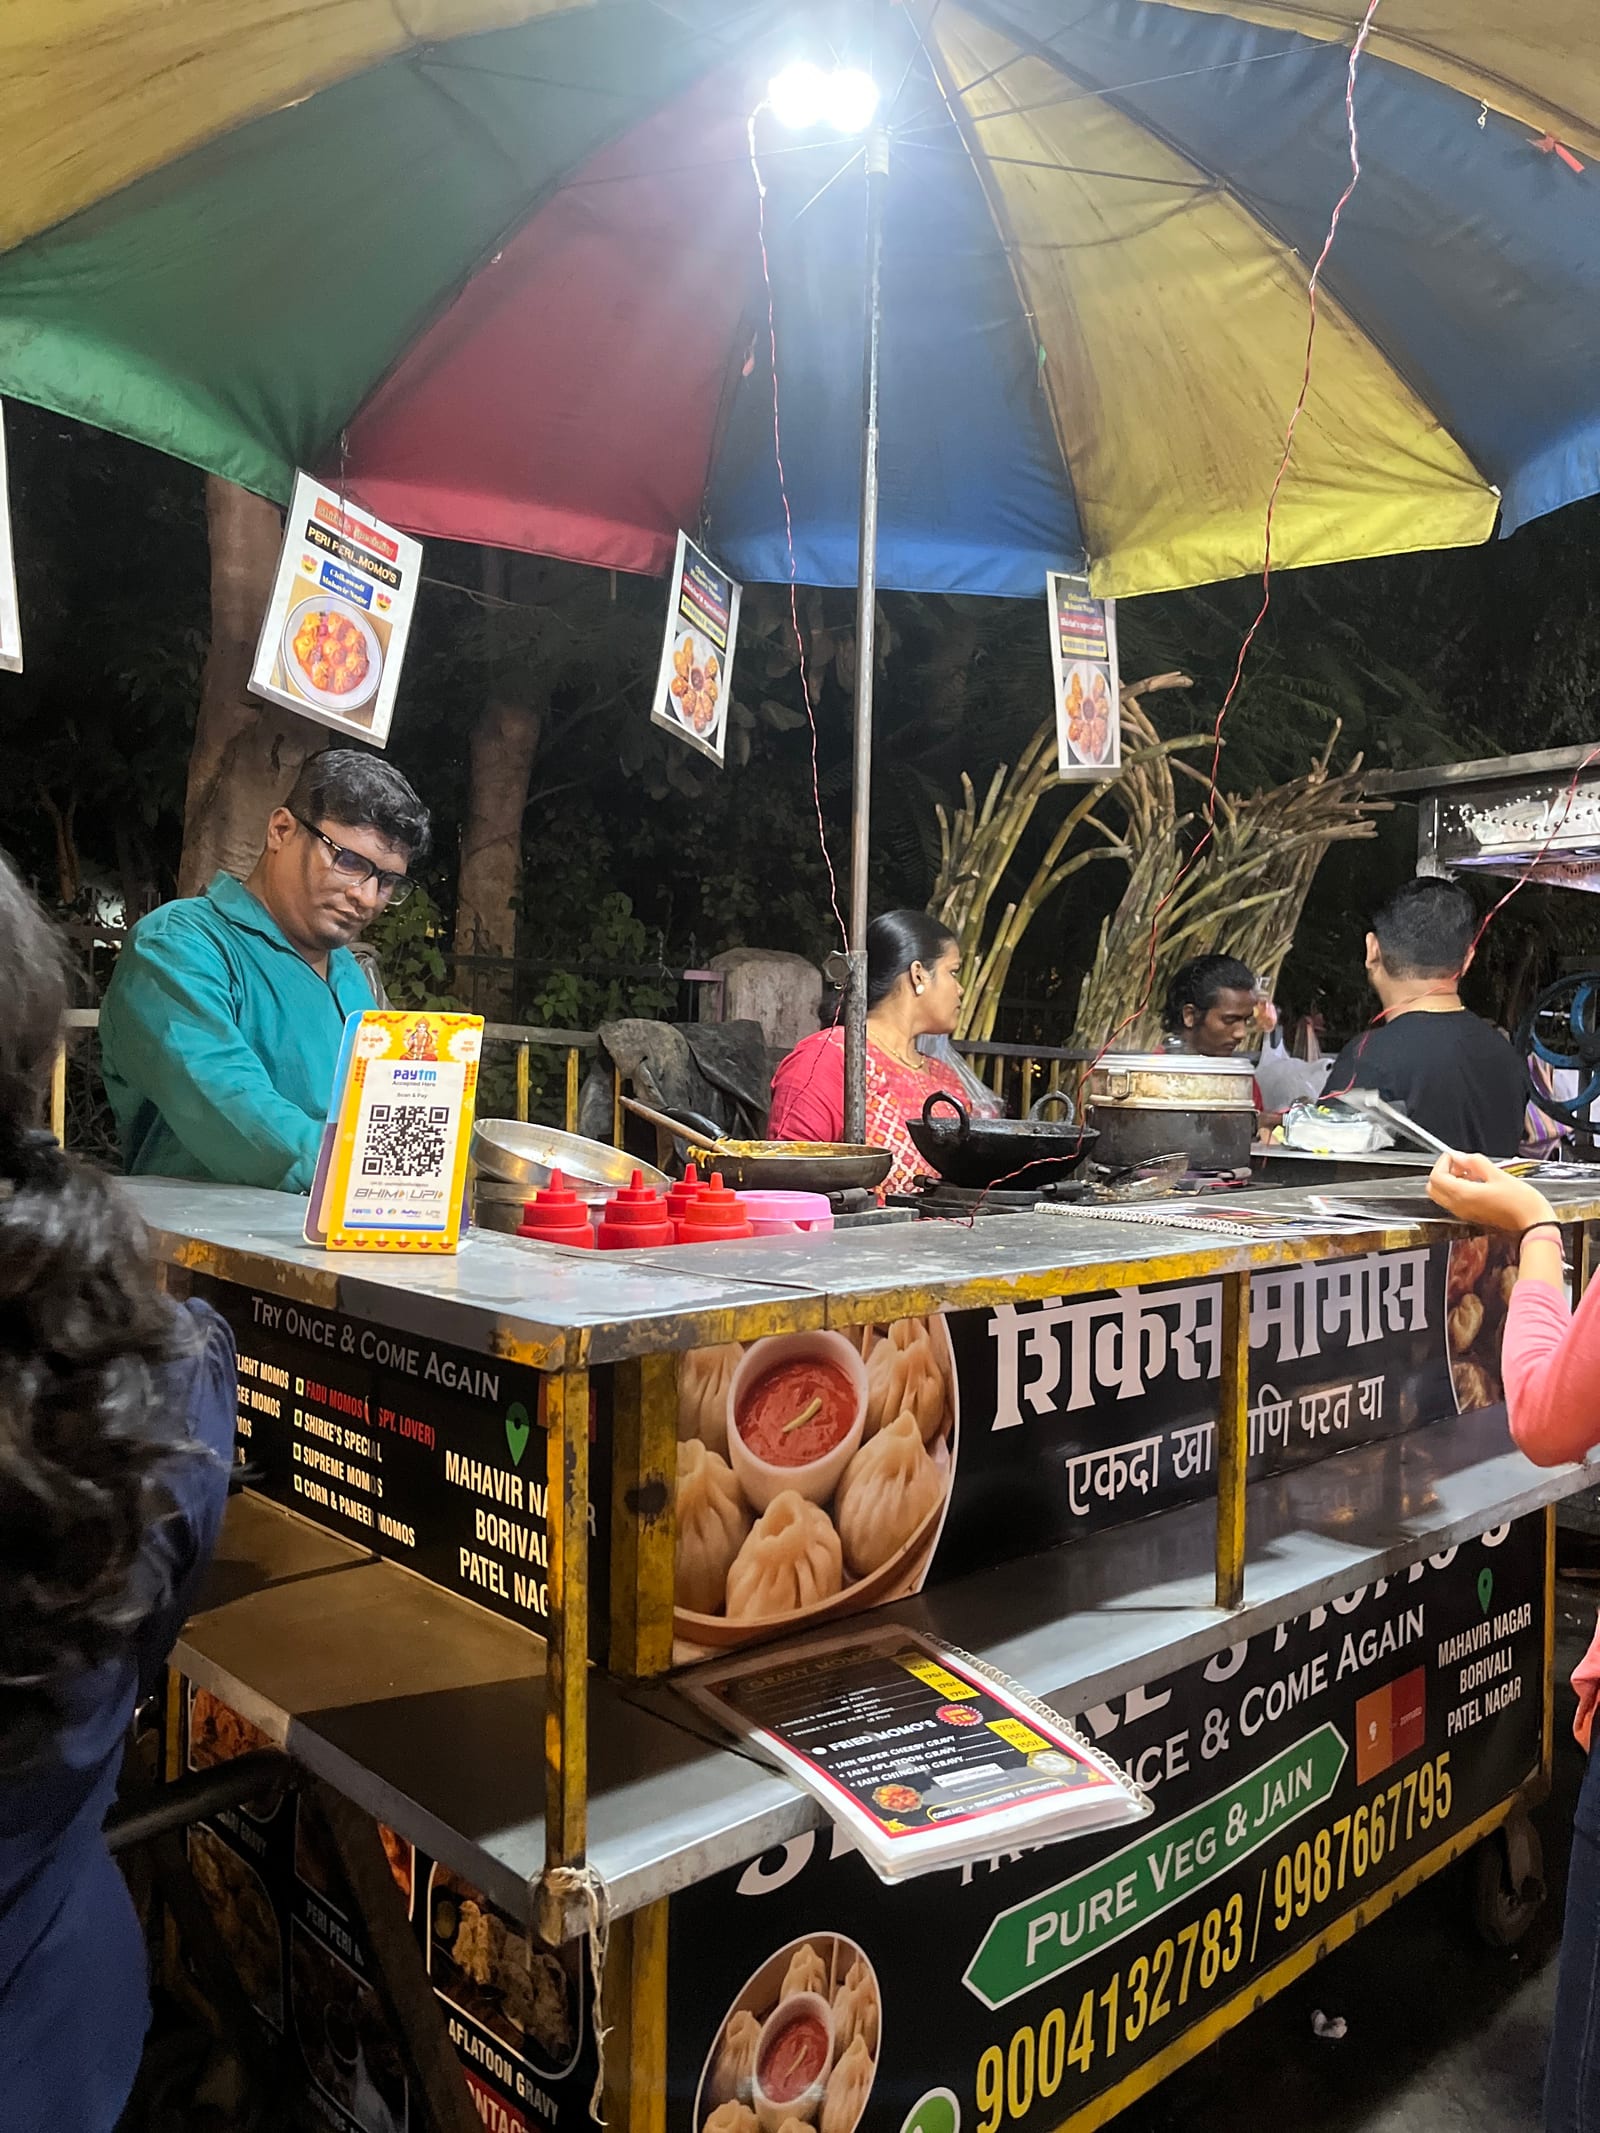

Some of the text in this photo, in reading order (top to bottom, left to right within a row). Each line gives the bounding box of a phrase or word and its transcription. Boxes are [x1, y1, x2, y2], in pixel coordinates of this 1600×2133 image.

[308, 526, 331, 547] PERI
[354, 1188, 438, 1199] BHIM UPI
[340, 1324, 355, 1354] &
[236, 1353, 289, 1390] LIGHT MOMOS
[251, 1390, 280, 1419] MOMOS
[306, 1380, 327, 1404] FADU
[329, 1389, 363, 1418] MOMOS
[400, 1415, 435, 1451] LOVER)
[304, 1412, 382, 1463] SHIRKE'S SPECIAL
[1066, 1435, 1163, 1516] एकदा
[1171, 1421, 1216, 1479] खा
[1300, 1383, 1353, 1439] परत
[1358, 1375, 1385, 1421] या
[303, 1446, 383, 1498] SUPREME MOMOS
[446, 1450, 523, 1509] MAHAVIR
[304, 1479, 415, 1548] CORN & PANEER MOMOS
[475, 1508, 549, 1569] BORIVAL
[459, 1547, 509, 1600] PATEL
[1438, 1602, 1532, 1669] MAHAVIR NAGAR
[1460, 1646, 1512, 1694] BORIVALI
[1448, 1675, 1522, 1738] PATEL NAGAR
[828, 1719, 938, 1752] FRIED MOMO'S
[857, 1751, 888, 1764] SUPER
[890, 1743, 925, 1755] CHEESY
[926, 1735, 956, 1748] GRAVY
[925, 1746, 957, 1759] GRAVY
[1201, 1708, 1229, 1760] &
[881, 1763, 930, 1782] CHINGARI
[931, 1755, 964, 1769] GRAVY
[1225, 1802, 1248, 1848] &
[976, 1750, 1452, 2133] 9004132783 / 9987667795
[448, 2016, 559, 2127] AFLATOON GRAVY
